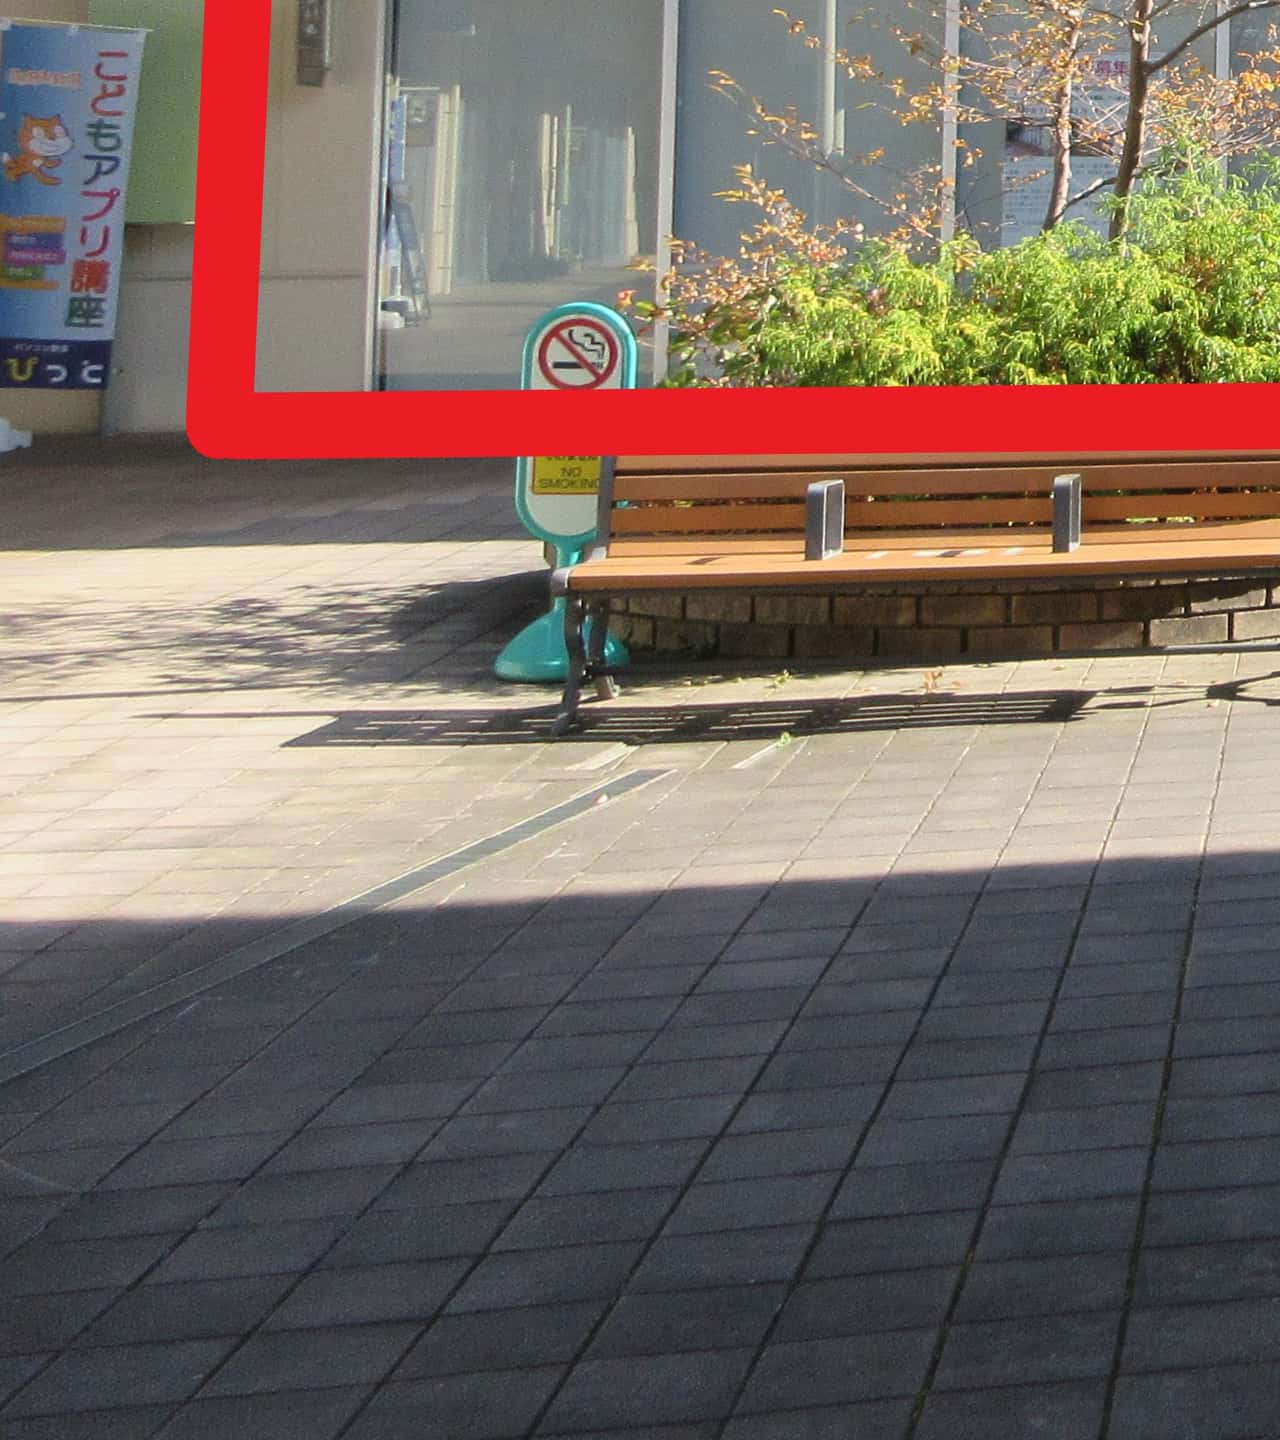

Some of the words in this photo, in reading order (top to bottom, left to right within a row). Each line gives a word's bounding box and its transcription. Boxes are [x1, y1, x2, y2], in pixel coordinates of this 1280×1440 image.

[65, 50, 129, 328] こどもアプリ講座
[561, 466, 582, 478] NO
